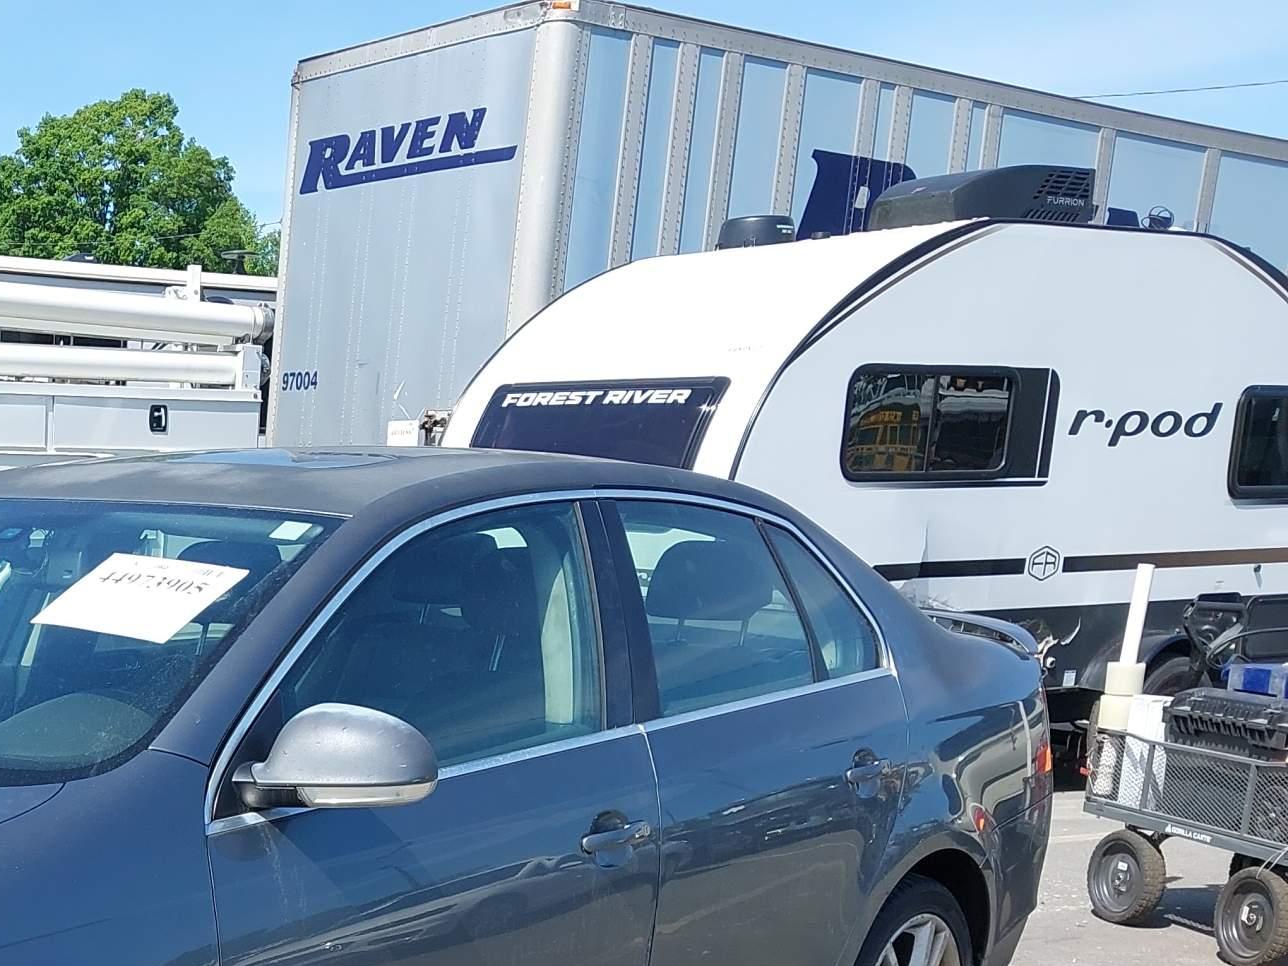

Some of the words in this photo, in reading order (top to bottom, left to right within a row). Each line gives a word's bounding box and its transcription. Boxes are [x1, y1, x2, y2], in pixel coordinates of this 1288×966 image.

[299, 107, 517, 195] RAVEN
[1047, 196, 1085, 207] FURRION
[282, 371, 318, 391] 97004
[502, 391, 604, 408] FOREST
[602, 389, 692, 405] RIVER
